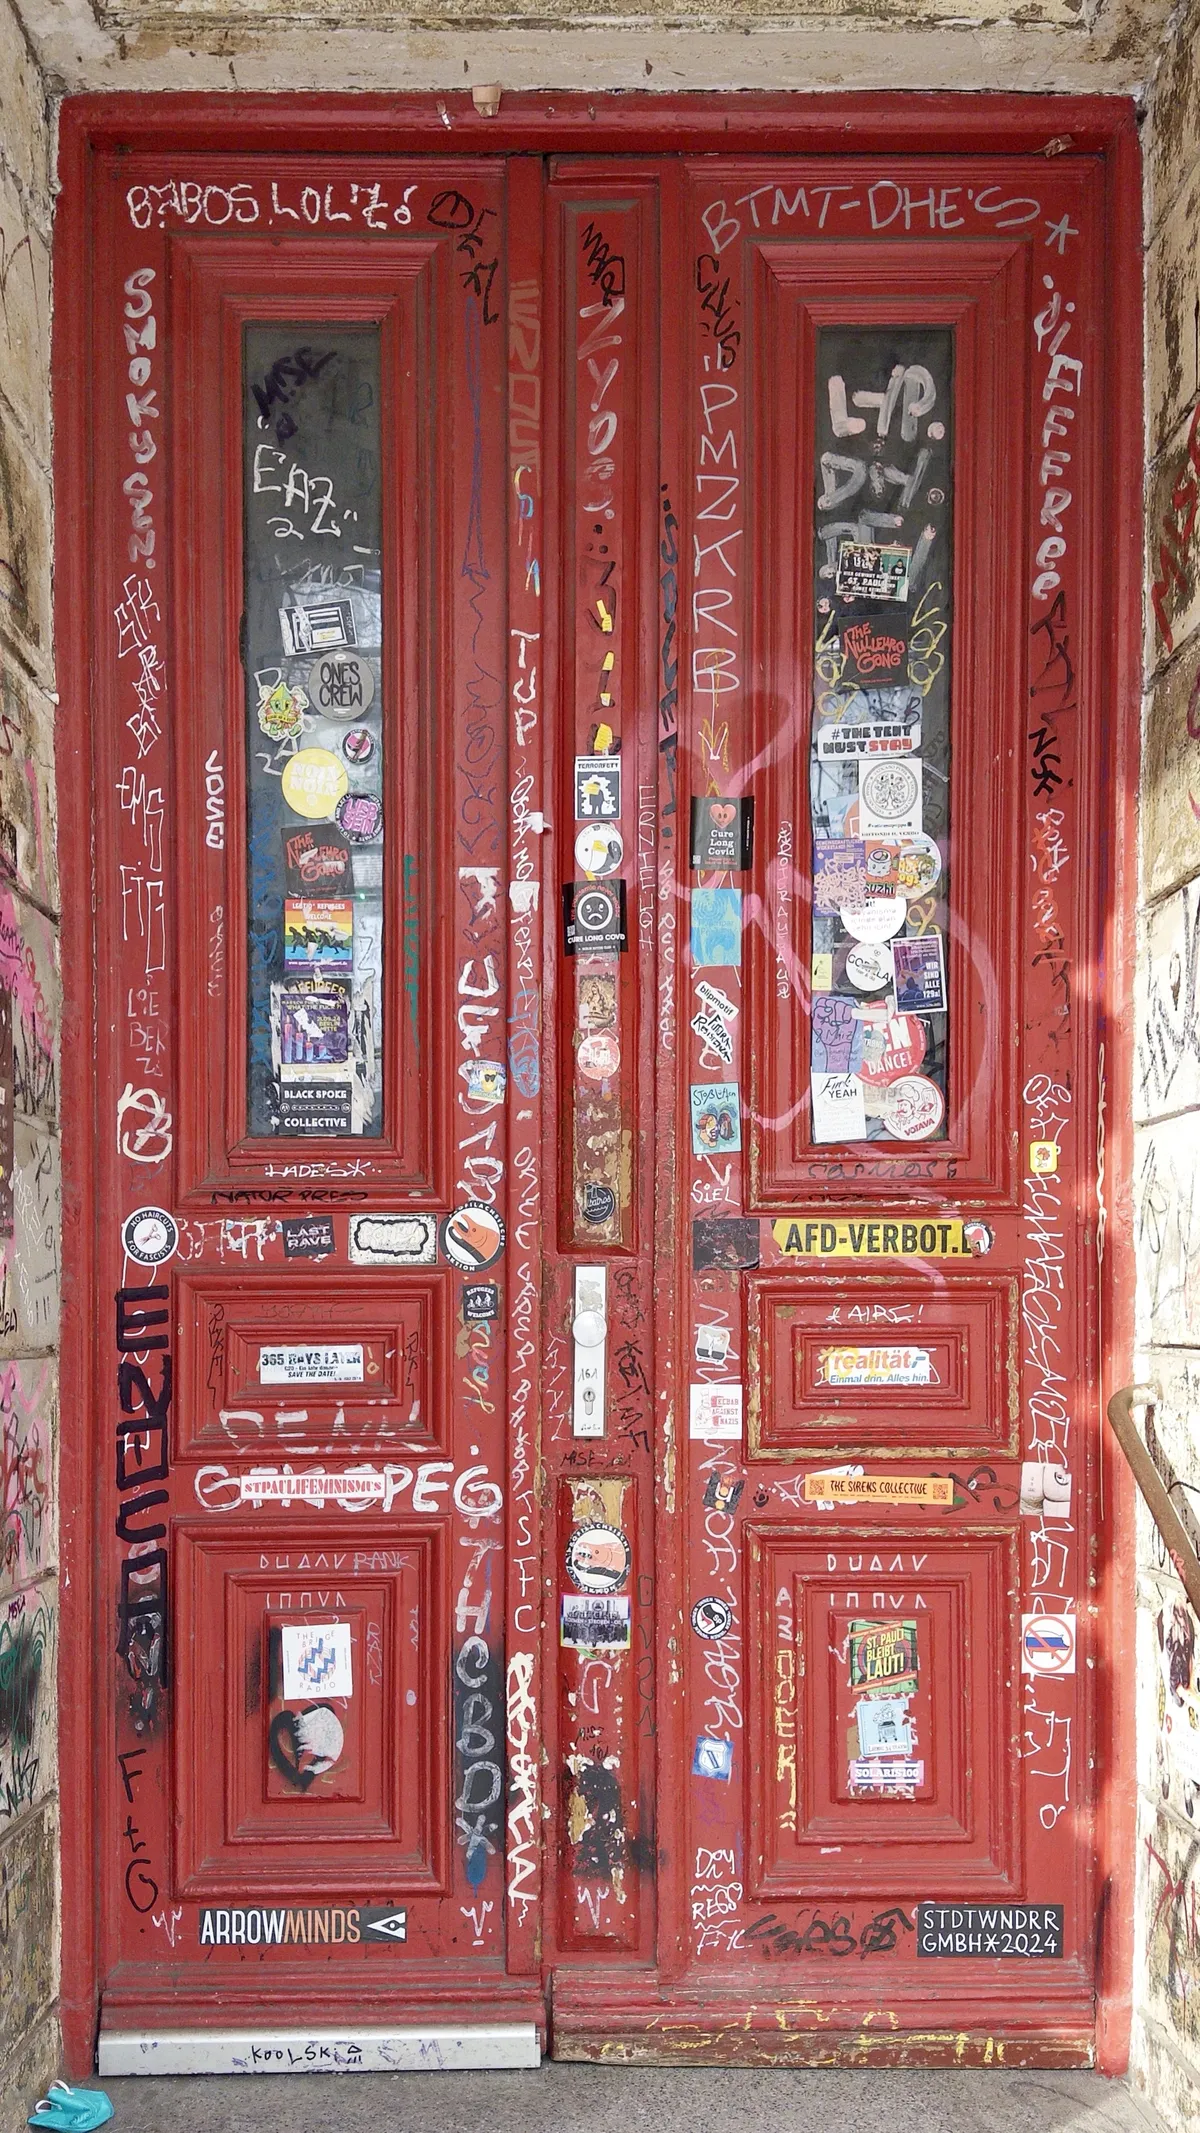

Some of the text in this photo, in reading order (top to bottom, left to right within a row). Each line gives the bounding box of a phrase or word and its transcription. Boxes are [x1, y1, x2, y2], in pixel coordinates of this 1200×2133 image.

[320, 661, 361, 685] ONES
[319, 684, 363, 708] CREW
[869, 738, 912, 752] STAY
[710, 829, 734, 838] Cure
[709, 838, 734, 848] Long
[707, 847, 735, 856] Covid
[567, 936, 584, 944] CURE
[584, 934, 604, 942] LONG
[925, 961, 939, 970] WIR
[923, 970, 940, 979] SIND
[924, 980, 941, 989] ALLE
[699, 984, 735, 1016] blipmotif
[284, 1089, 347, 1099] BLACK SPOKE
[828, 1088, 857, 1099] YEAH
[284, 1117, 347, 1128] COLLECTIVE
[903, 1117, 936, 1137] VOTAVA
[141, 1211, 175, 1233] HAIRCUTS
[287, 1236, 332, 1249] RAVE
[139, 1244, 172, 1263] FASCISTS
[261, 1353, 285, 1366] 365
[830, 1373, 930, 1384] Einmal drin. Alles hin.
[719, 1417, 739, 1425] NAZIS
[244, 1478, 383, 1495] STPAULIFEMINISMUS
[830, 1480, 928, 1495] THE SIRENS COLLECTIVE
[296, 1631, 314, 1640] THE
[866, 1628, 905, 1650] ST. PAULI
[866, 1644, 896, 1661] BLEIBT
[866, 1652, 905, 1681] LAUT!
[299, 1682, 336, 1693] RADIO
[855, 1767, 920, 1778] SOLARIS100
[923, 1908, 1060, 1930] STDTWNDRR
[201, 1909, 361, 1944] ARROWMINDS
